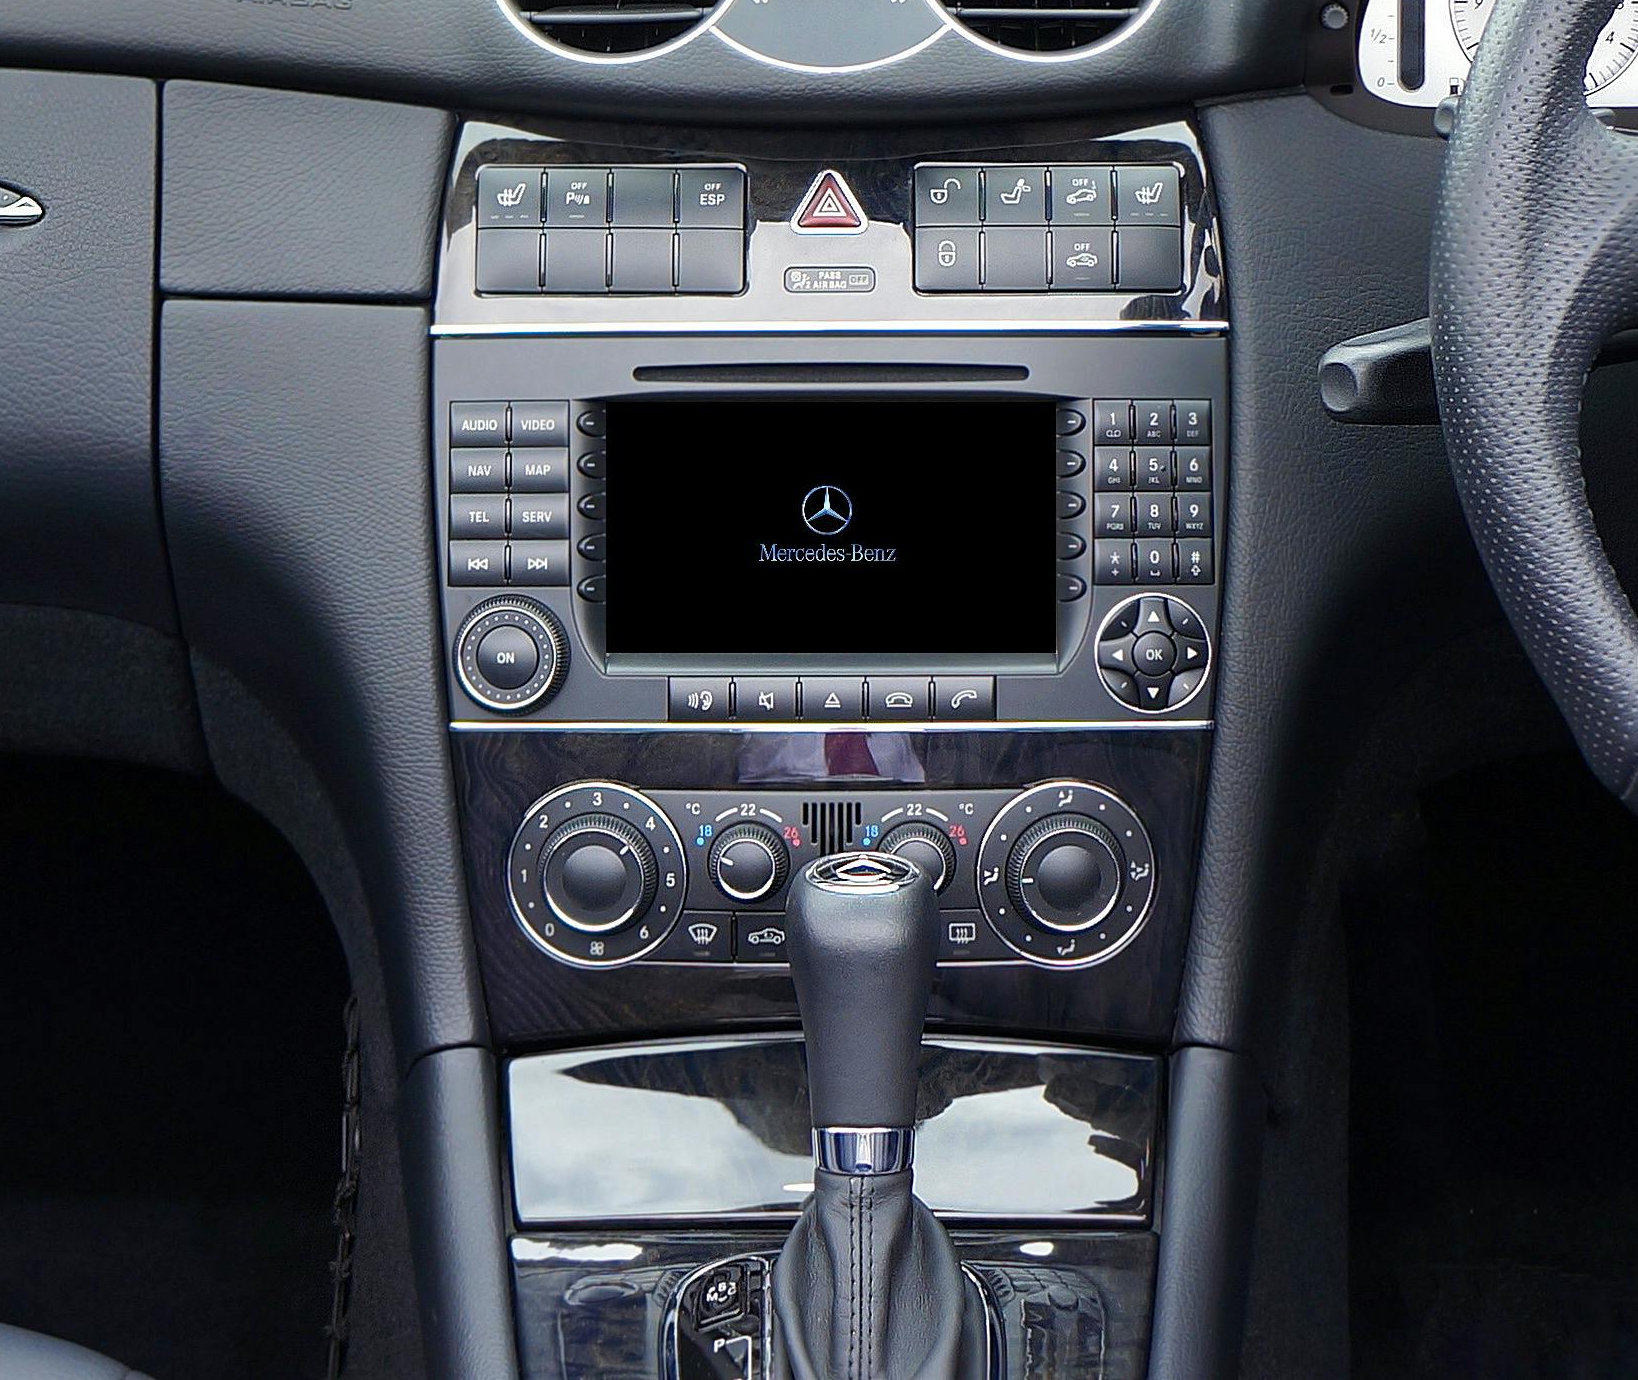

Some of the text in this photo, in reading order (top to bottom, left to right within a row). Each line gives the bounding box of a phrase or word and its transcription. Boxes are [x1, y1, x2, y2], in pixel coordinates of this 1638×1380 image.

[1370, 28, 1387, 45] 1/2
[1605, 31, 1615, 44] 4
[1377, 78, 1386, 87] 0
[570, 181, 588, 191] OFF
[704, 182, 722, 191] OFF
[1071, 178, 1089, 188] OFF
[699, 193, 726, 207] ESP
[1073, 242, 1091, 252] OFF
[818, 271, 841, 280] PASS
[850, 276, 868, 284] OFF
[812, 280, 847, 289] AIRBAG
[461, 419, 498, 431] AUDIO
[520, 419, 555, 431] VIDEO
[1110, 412, 1116, 426] 1
[1149, 412, 1159, 426] 2
[1188, 412, 1198, 426] 3
[468, 465, 492, 477] NAV
[524, 465, 551, 476] MAP
[1109, 458, 1119, 472] 4
[1149, 458, 1159, 472] 5
[1189, 458, 1199, 472] 6
[469, 511, 490, 523] TEL
[522, 511, 552, 523] SERV
[1111, 504, 1121, 518] 7
[1150, 504, 1159, 518] 8
[1189, 504, 1199, 518] 9
[758, 543, 897, 562] Mercedes-Benz
[1149, 550, 1160, 564] 0
[496, 652, 516, 664] ON
[1146, 649, 1164, 661] OK
[592, 792, 602, 806] 3
[686, 803, 701, 815] °C
[740, 803, 757, 817] 22
[906, 803, 923, 816] 22
[958, 803, 974, 815] °C
[539, 815, 549, 829] 2
[645, 816, 656, 831] 4
[699, 824, 713, 837] 18
[783, 826, 800, 839] 26
[865, 824, 879, 838] 18
[948, 824, 966, 838] 26
[520, 869, 528, 883] 1
[665, 873, 676, 887] 5
[544, 923, 555, 937] 0
[639, 925, 649, 939] 6
[714, 1338, 726, 1353] P
